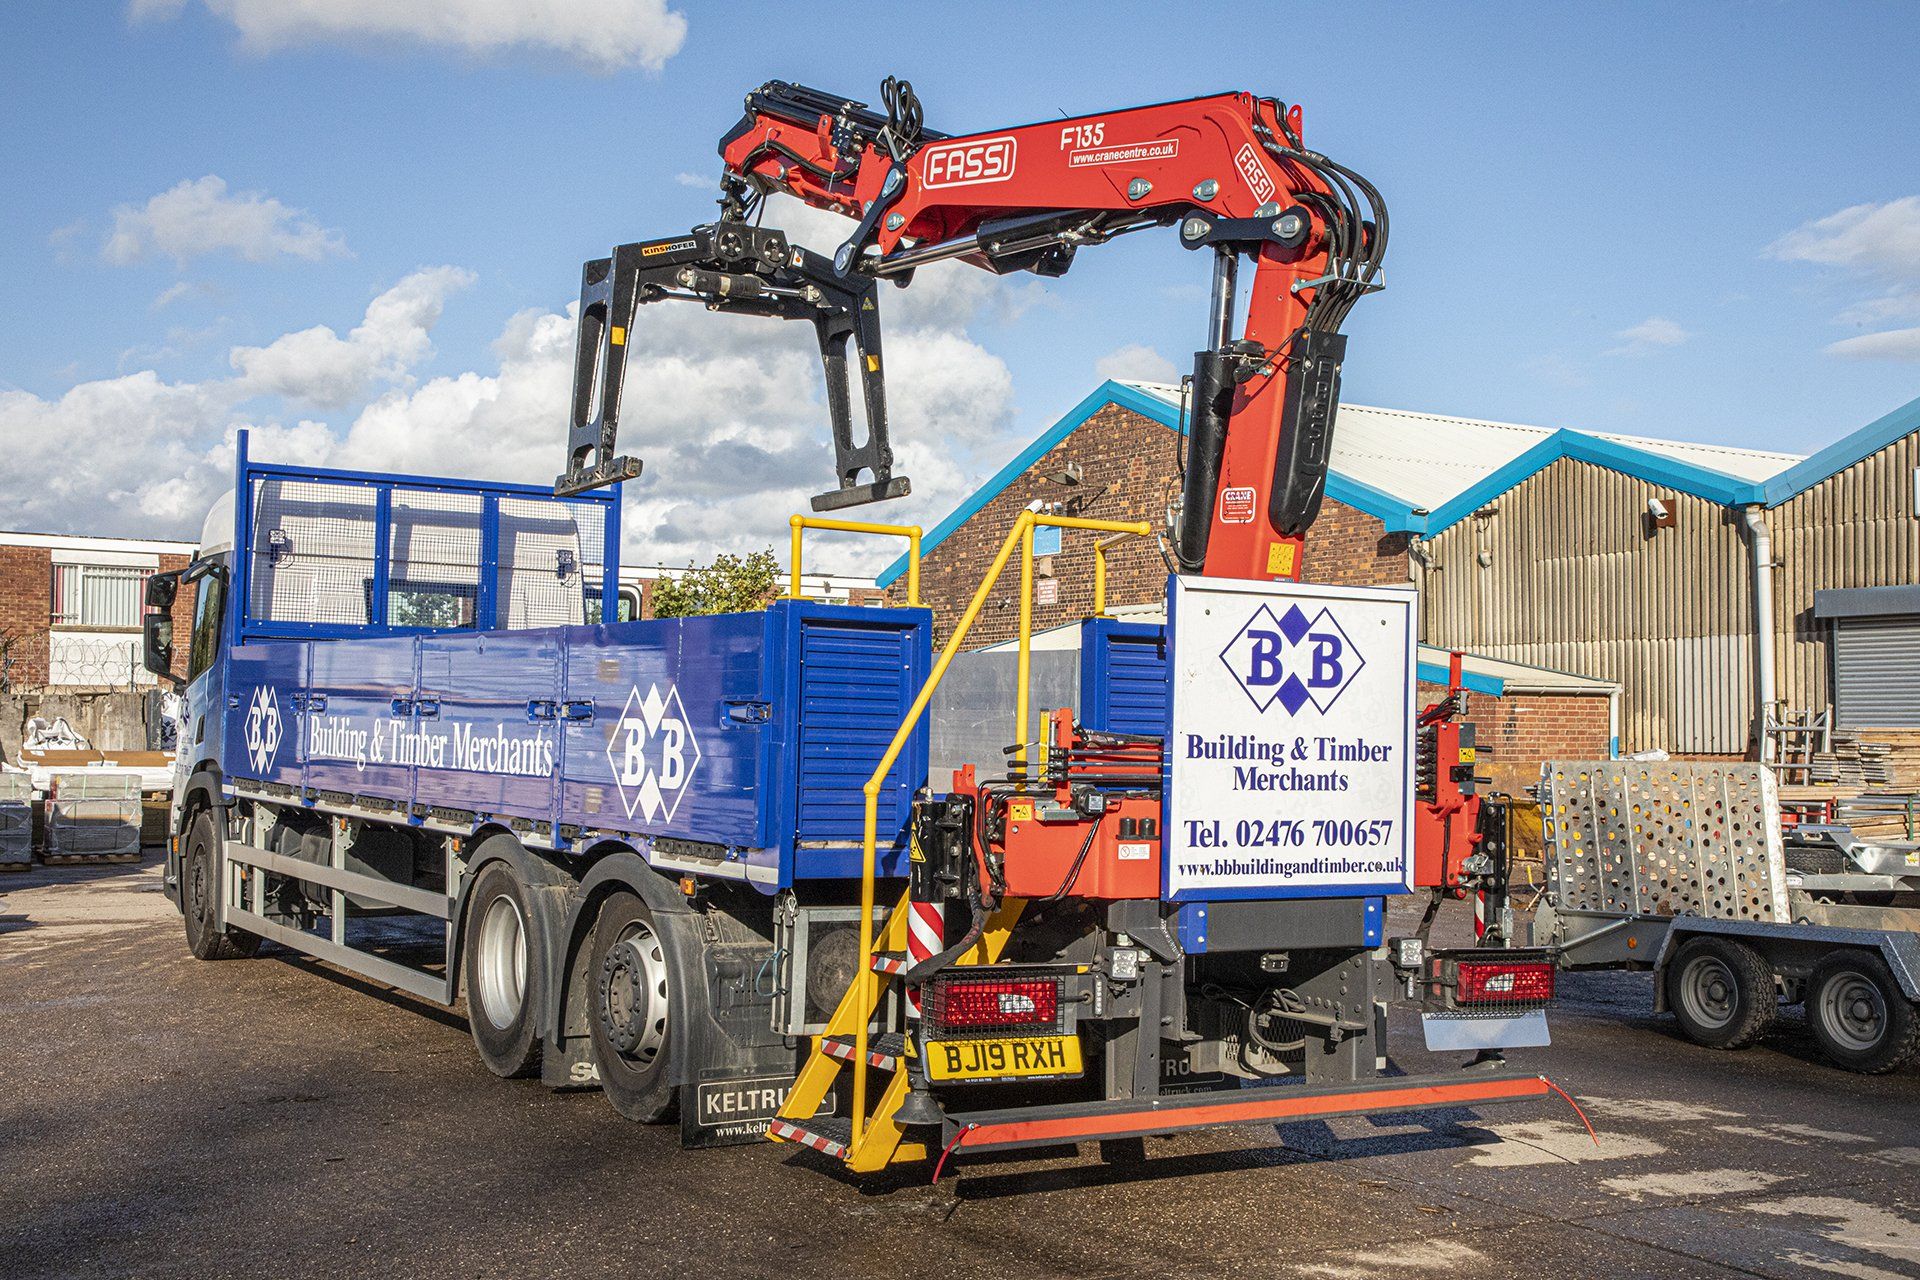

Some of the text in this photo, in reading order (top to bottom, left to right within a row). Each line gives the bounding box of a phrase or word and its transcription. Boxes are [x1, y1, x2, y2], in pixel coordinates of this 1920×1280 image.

[1060, 122, 1105, 151] F135
[929, 143, 1010, 183] FASSI
[1073, 143, 1174, 165] www.cranecentre.co.uk
[1239, 150, 1271, 199] FASSI
[643, 241, 695, 255] KINSHOFER
[1225, 491, 1252, 501] CRANE
[309, 715, 553, 778] Building & Timber Merchants
[1186, 733, 1393, 767] Building & Timber
[1232, 766, 1349, 792] Merchants
[1184, 819, 1393, 848] Tel. 02476 700657
[1178, 856, 1406, 879] www.bbbuildingandtimber.co.uk
[944, 1040, 1066, 1073] BJ19 RXH
